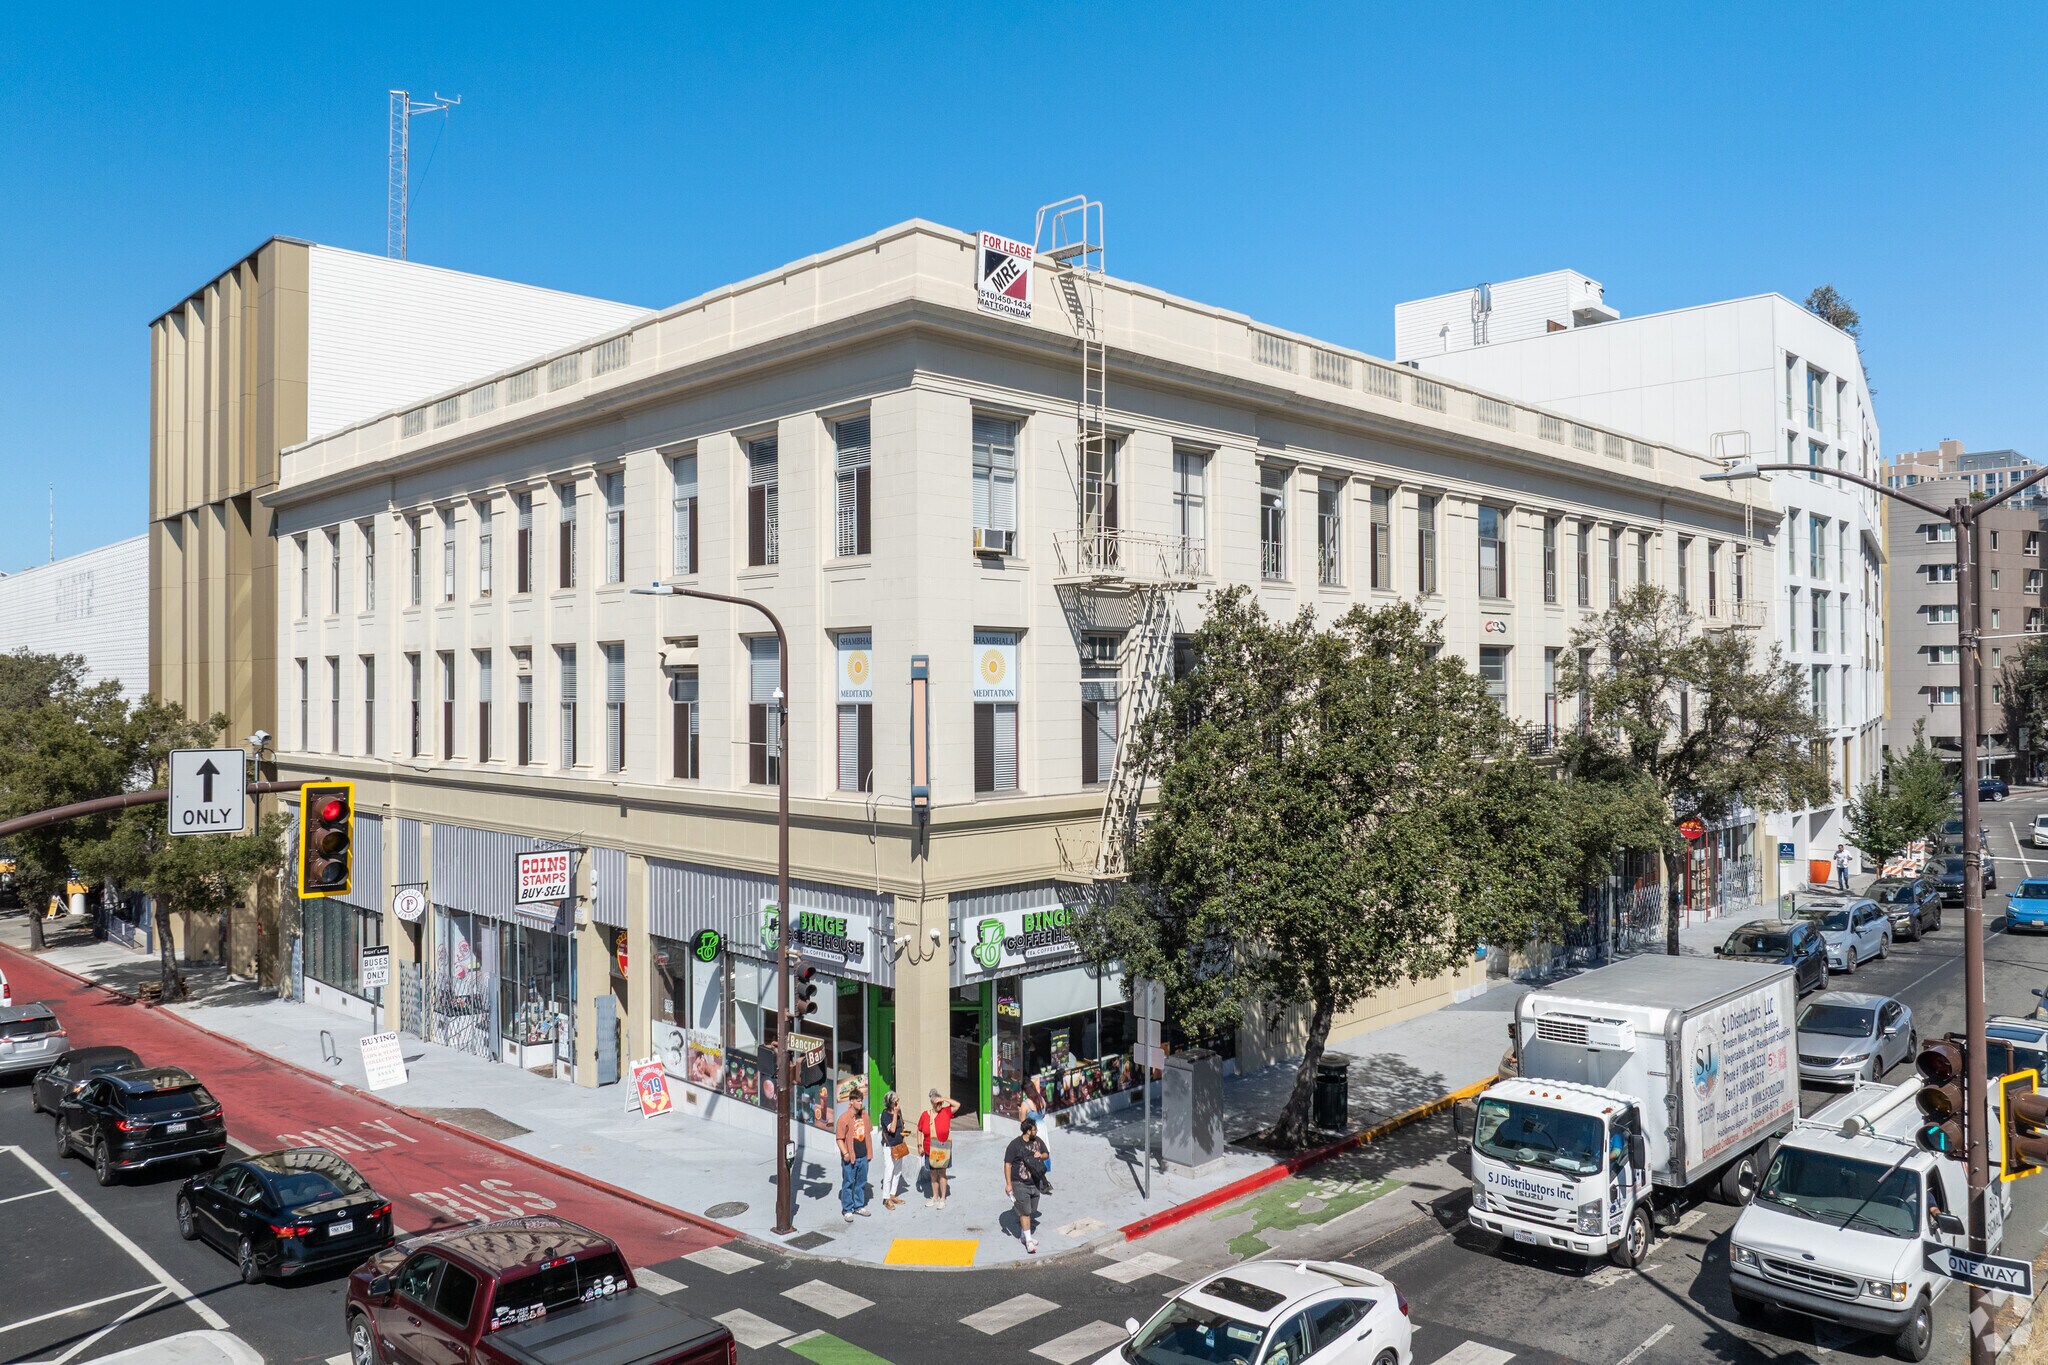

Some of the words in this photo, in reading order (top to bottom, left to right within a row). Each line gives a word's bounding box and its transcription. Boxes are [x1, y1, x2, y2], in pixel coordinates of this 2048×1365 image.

[984, 234, 1000, 249] FOR
[1004, 240, 1032, 259] LEASE
[992, 258, 1020, 292] MRE
[840, 637, 872, 646] SHAMBHAL
[183, 808, 231, 825] ONLY
[522, 856, 566, 874] COINS
[523, 872, 566, 886] STAMPS
[522, 885, 566, 899] BUY-SELL
[800, 912, 844, 936] BINGE
[824, 935, 863, 955] HOUSE
[1007, 930, 1051, 950] COFFEE
[364, 958, 387, 966] BUSES
[810, 950, 826, 958] COFFEE
[367, 971, 384, 979] ONLY
[998, 1004, 1020, 1017] OPEN
[1722, 1017, 1726, 1034] S
[1730, 1006, 1761, 1031] Distributors
[1765, 997, 1773, 1015] LLC
[362, 1033, 395, 1046] BUYING
[1696, 1044, 1712, 1076] SJ
[1488, 1172, 1493, 1182] S
[1495, 1174, 1498, 1184] J
[1502, 1175, 1554, 1196] Distributors
[1557, 1187, 1574, 1200] Inc.
[1516, 1190, 1543, 1200] ISUZU
[410, 1179, 557, 1226] BUS
[1949, 1257, 1978, 1275] ONE
[1982, 1265, 2017, 1282] WAY
